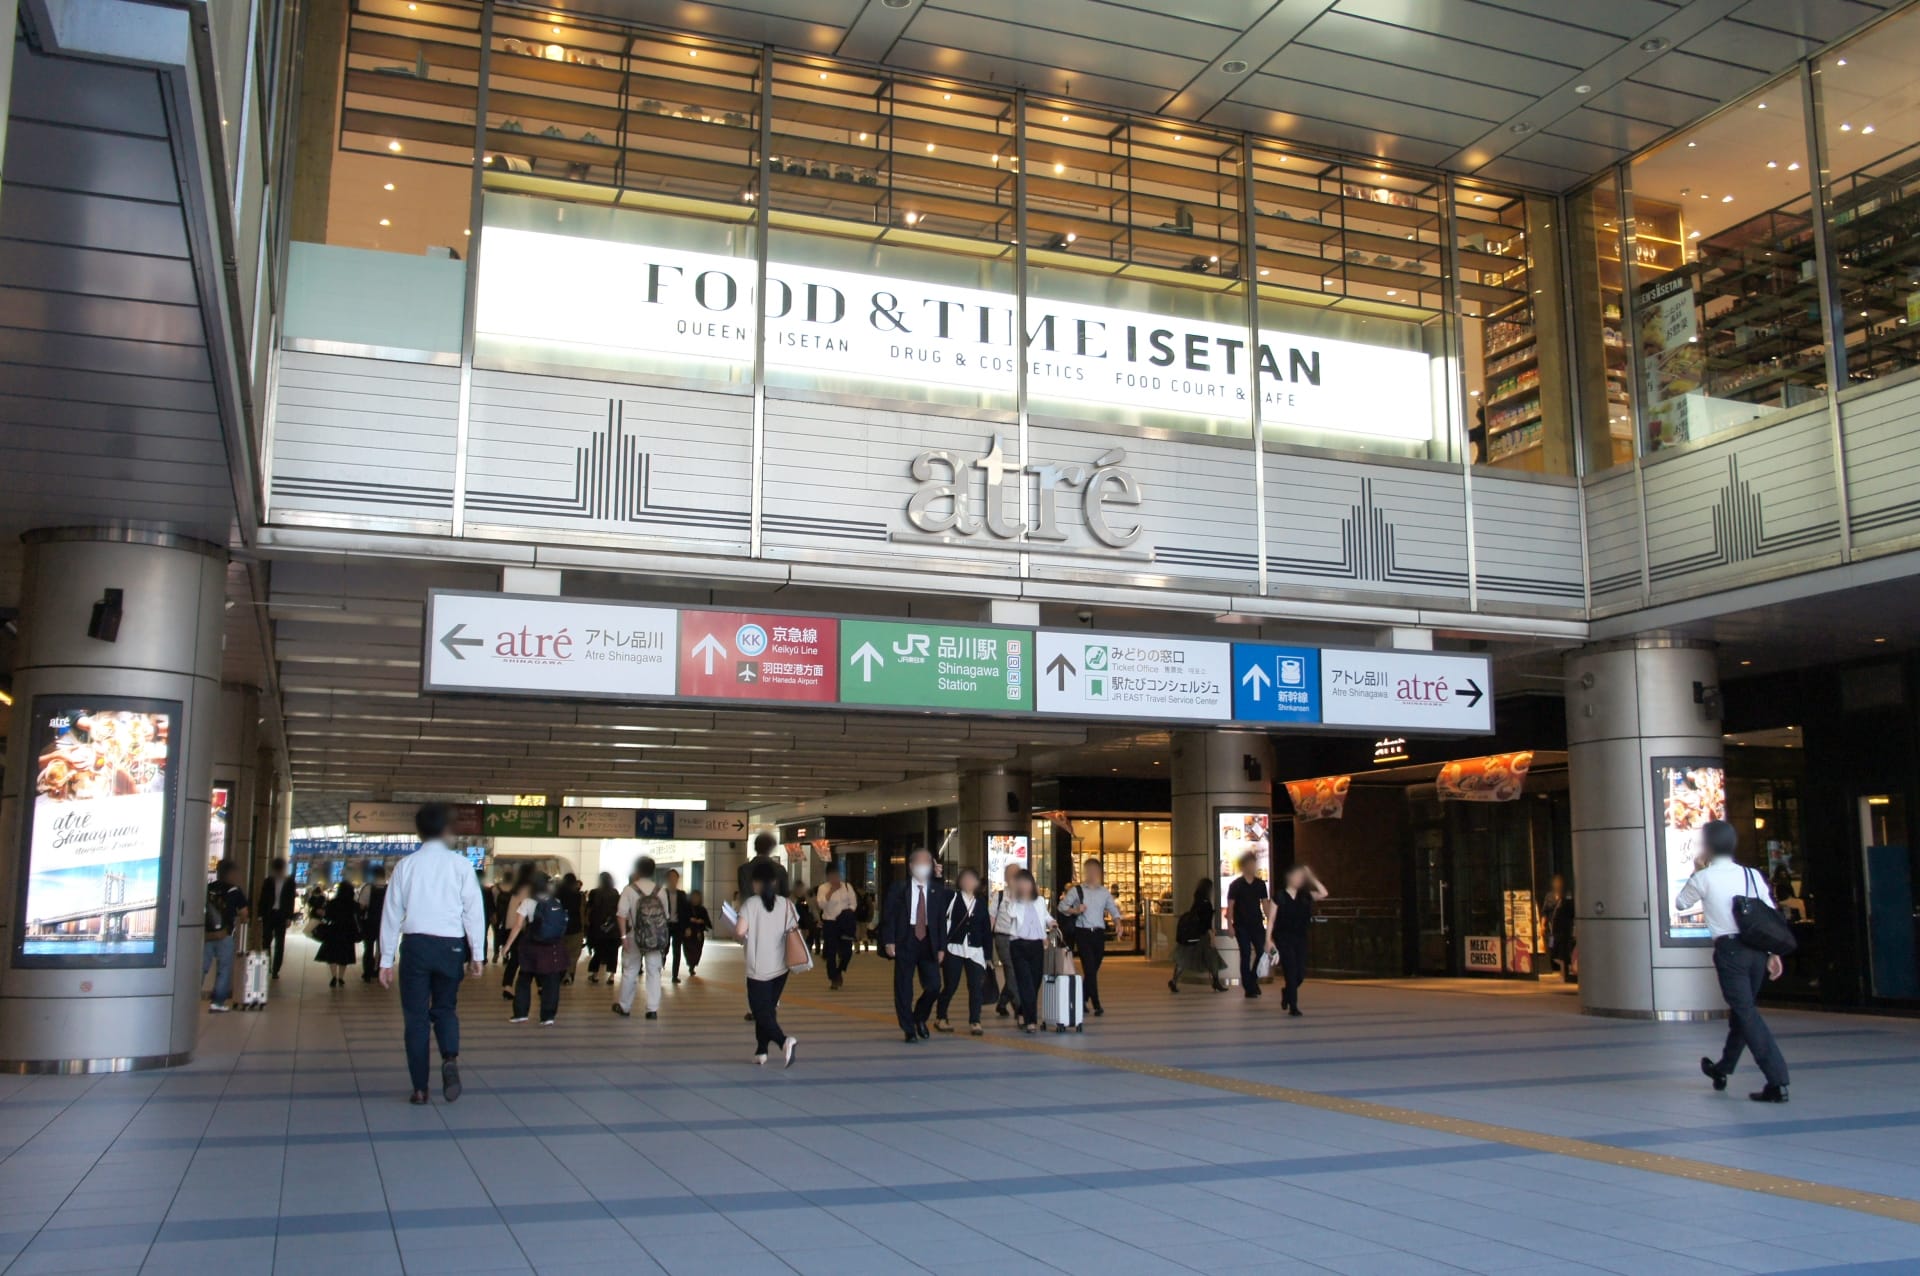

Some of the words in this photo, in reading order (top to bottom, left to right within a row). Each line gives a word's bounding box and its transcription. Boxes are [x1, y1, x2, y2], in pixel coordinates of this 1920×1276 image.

[642, 262, 846, 324] FOOD
[869, 291, 913, 334] &
[922, 299, 1108, 358] TIME
[1126, 325, 1321, 387] ISETAN
[778, 331, 848, 352] ISETAN
[890, 345, 942, 363] DRUG
[955, 352, 967, 367] &
[980, 355, 1085, 381] COSETICS
[1115, 372, 1161, 390] FOOD
[1171, 379, 1225, 397] COURT
[1236, 387, 1245, 400] &
[1265, 392, 1296, 407] AFE
[906, 432, 1145, 549] atré
[495, 624, 573, 659] atré
[585, 628, 664, 650] アトレ品川
[742, 634, 760, 646] KK
[772, 626, 818, 644] 京急線
[801, 646, 818, 655] Line
[892, 633, 931, 657] JR
[937, 636, 998, 661] 品川駅
[584, 650, 605, 661] Atre
[608, 651, 663, 665] Shinagawa
[1111, 647, 1185, 664] みどりの窓口
[762, 662, 824, 677] 羽田空港方面
[938, 661, 1000, 679] Shinagawa
[1112, 663, 1135, 672] Ticket
[1136, 663, 1159, 673] Office
[938, 677, 977, 692] Station
[1111, 676, 1221, 694] 駅たびコンシェルジュ
[1331, 669, 1389, 687] アトレ品川
[1349, 688, 1389, 700] Shinagawa
[1396, 673, 1449, 702] atré
[1111, 693, 1122, 702] JR
[1123, 693, 1144, 702] EAST
[1145, 694, 1167, 703] Travel
[1168, 695, 1194, 704] Service
[1195, 696, 1218, 705] Center
[1470, 939, 1488, 951] MEAT
[1470, 953, 1497, 965] CHEERS
